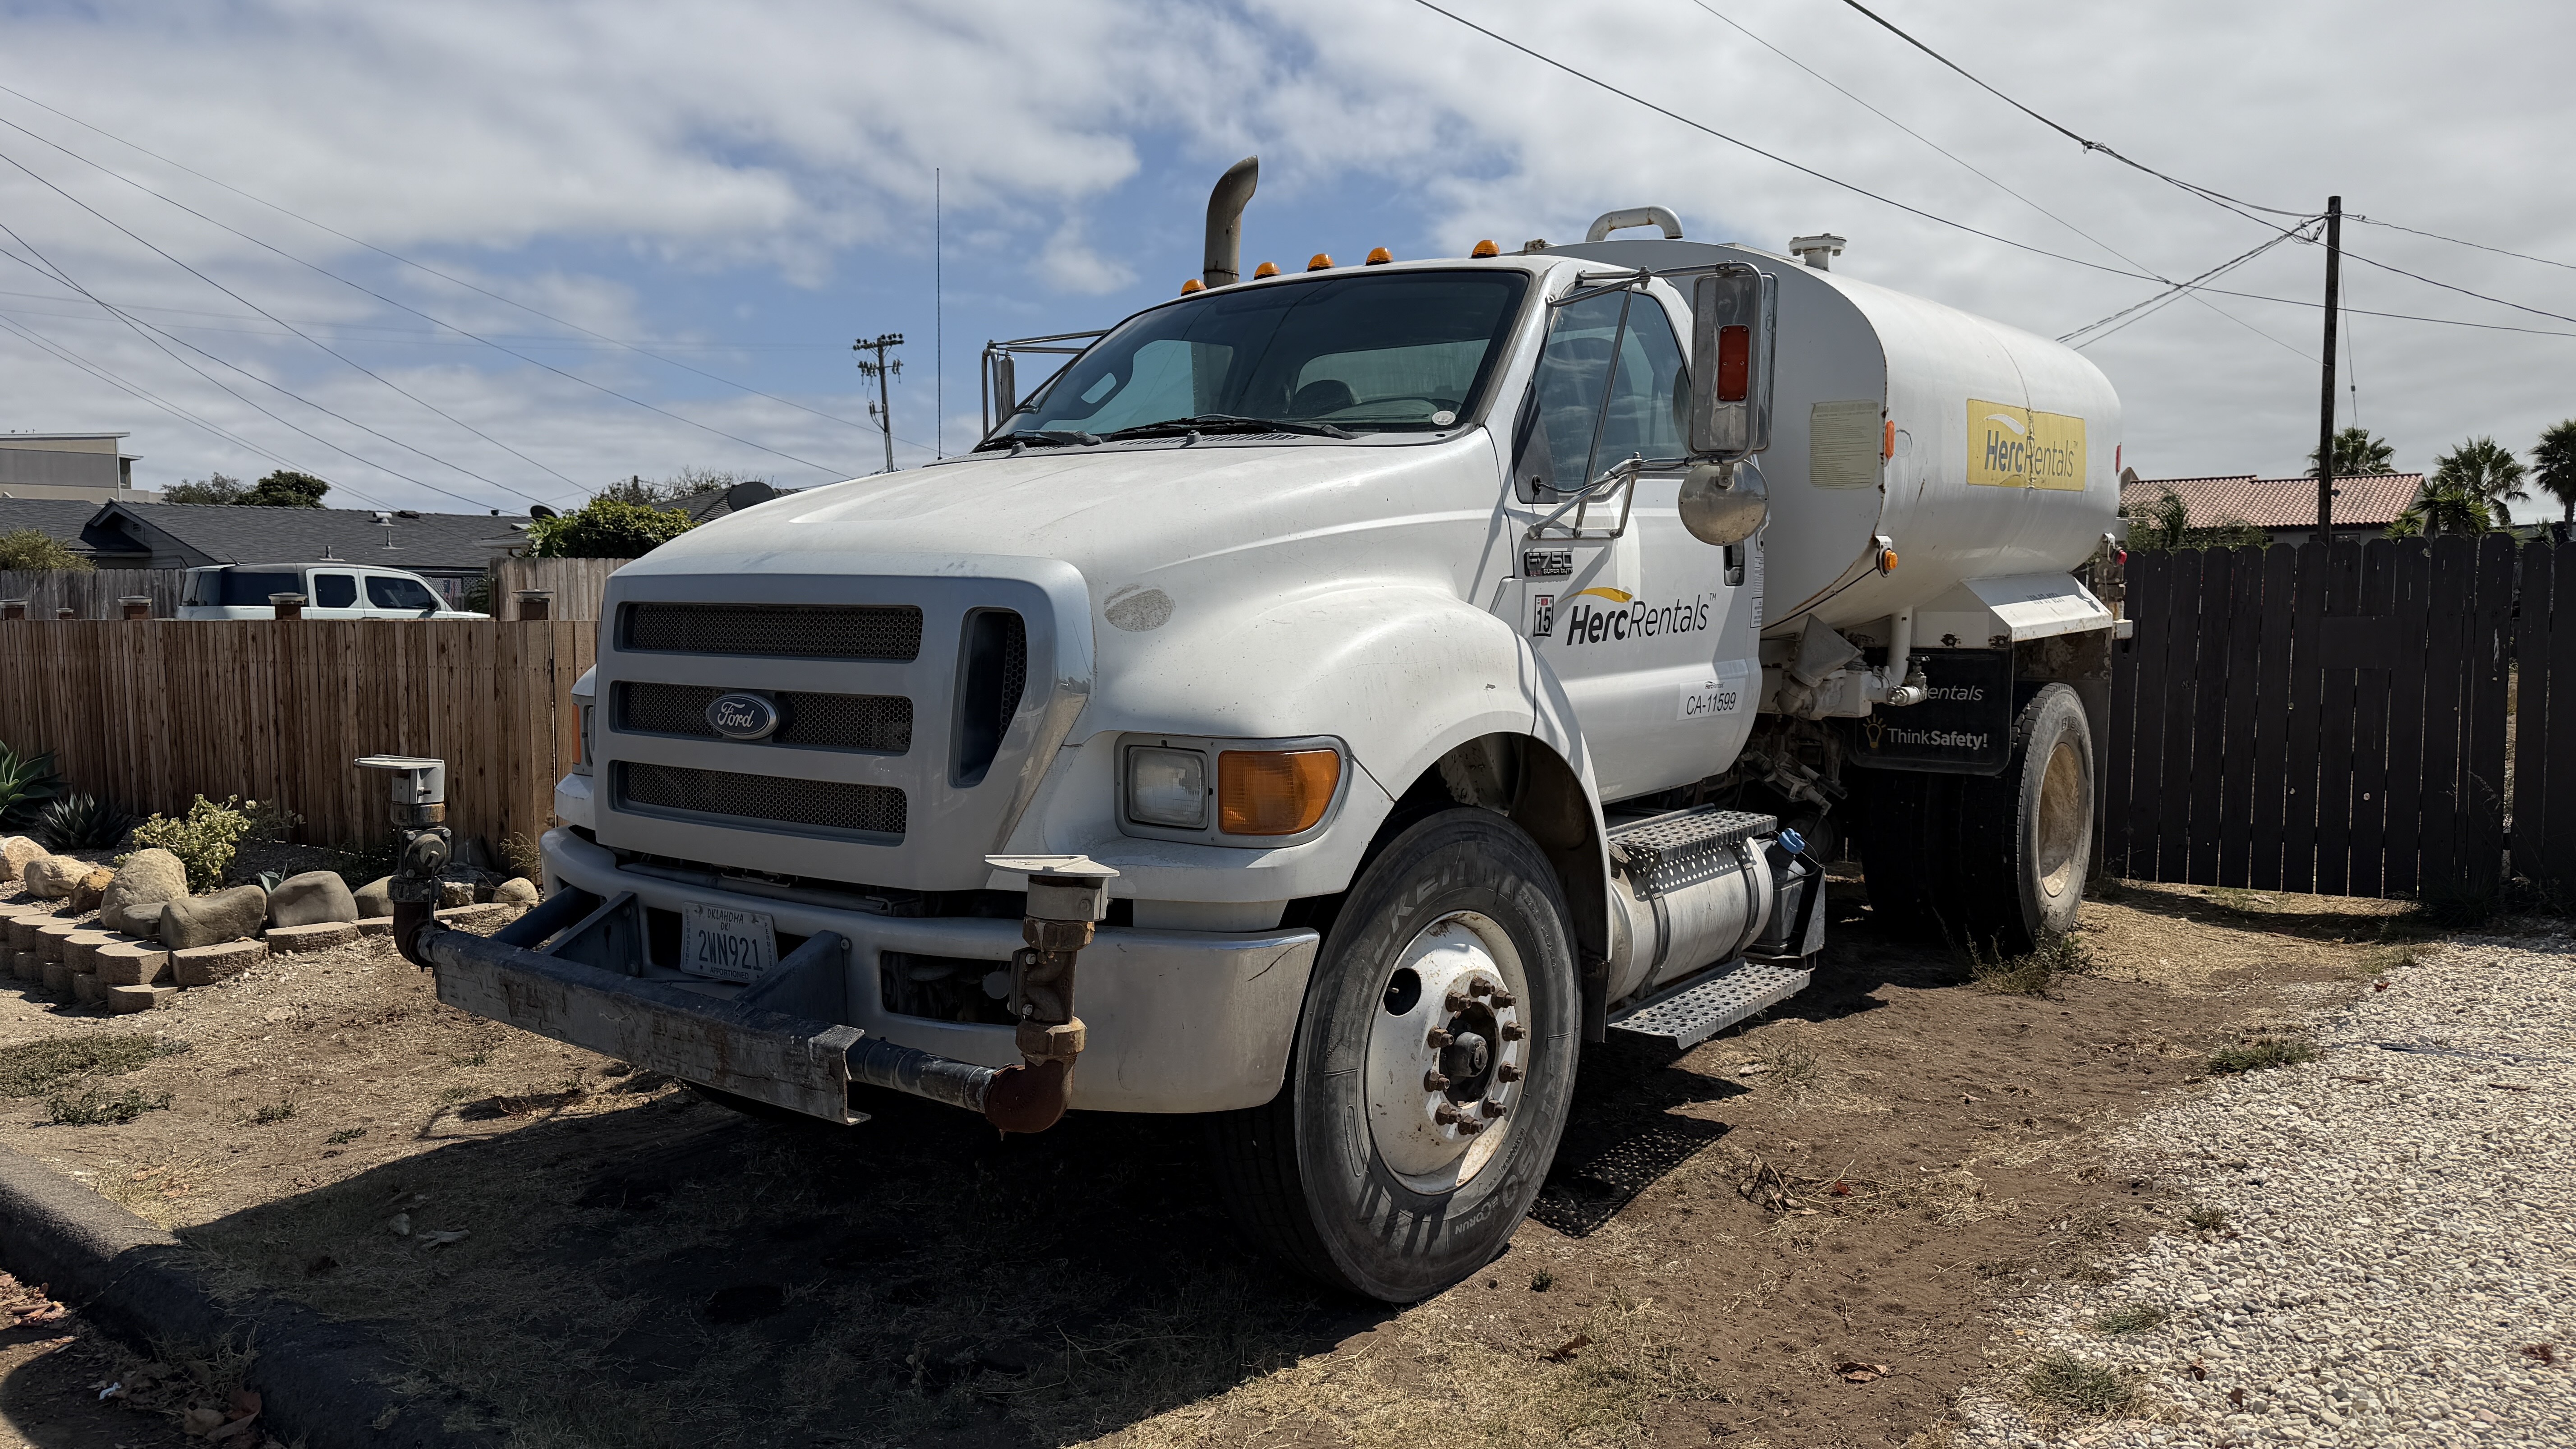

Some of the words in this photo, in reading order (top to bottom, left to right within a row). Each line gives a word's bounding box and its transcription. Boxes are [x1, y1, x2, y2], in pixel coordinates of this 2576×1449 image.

[1984, 430, 2074, 477] HercRentals
[1537, 607, 1551, 632] 15
[1567, 594, 1709, 645] HercRentals
[1687, 692, 1736, 715] CA-11599
[1927, 685, 1983, 701] entals
[718, 702, 754, 727] Ford
[1887, 728, 1987, 750] ThinkSafety!
[708, 908, 743, 924] OKLAHOMA
[699, 930, 763, 971] 2WN921
[764, 922, 773, 966] PERMANE
[710, 965, 749, 979] APPORTIONED
